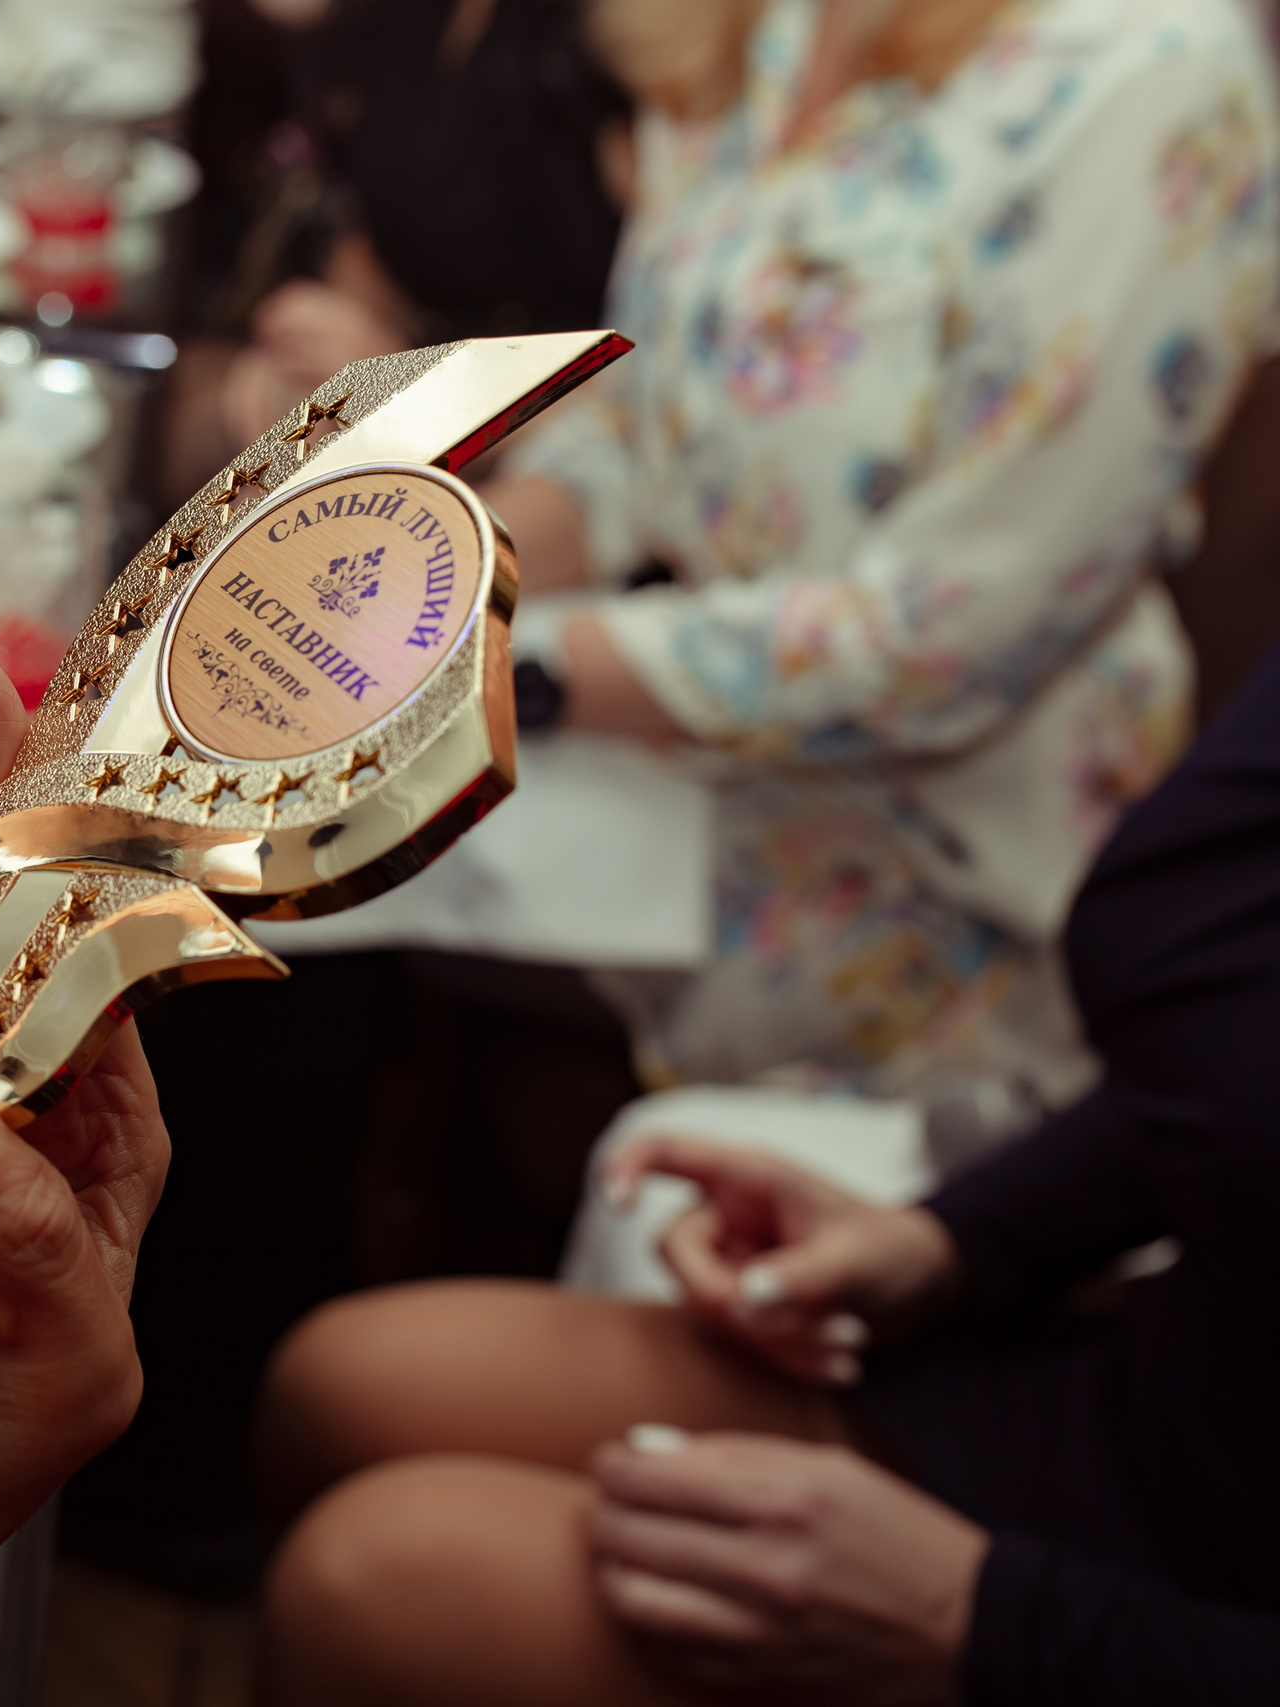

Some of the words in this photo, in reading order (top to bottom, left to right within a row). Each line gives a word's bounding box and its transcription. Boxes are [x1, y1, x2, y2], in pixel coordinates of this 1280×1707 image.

[267, 487, 408, 543] САМЫЙ
[400, 507, 455, 651] ЛУЧШИЙ
[220, 571, 379, 702] НАСТАВНИК
[224, 627, 253, 653] на
[249, 648, 312, 702] свете
